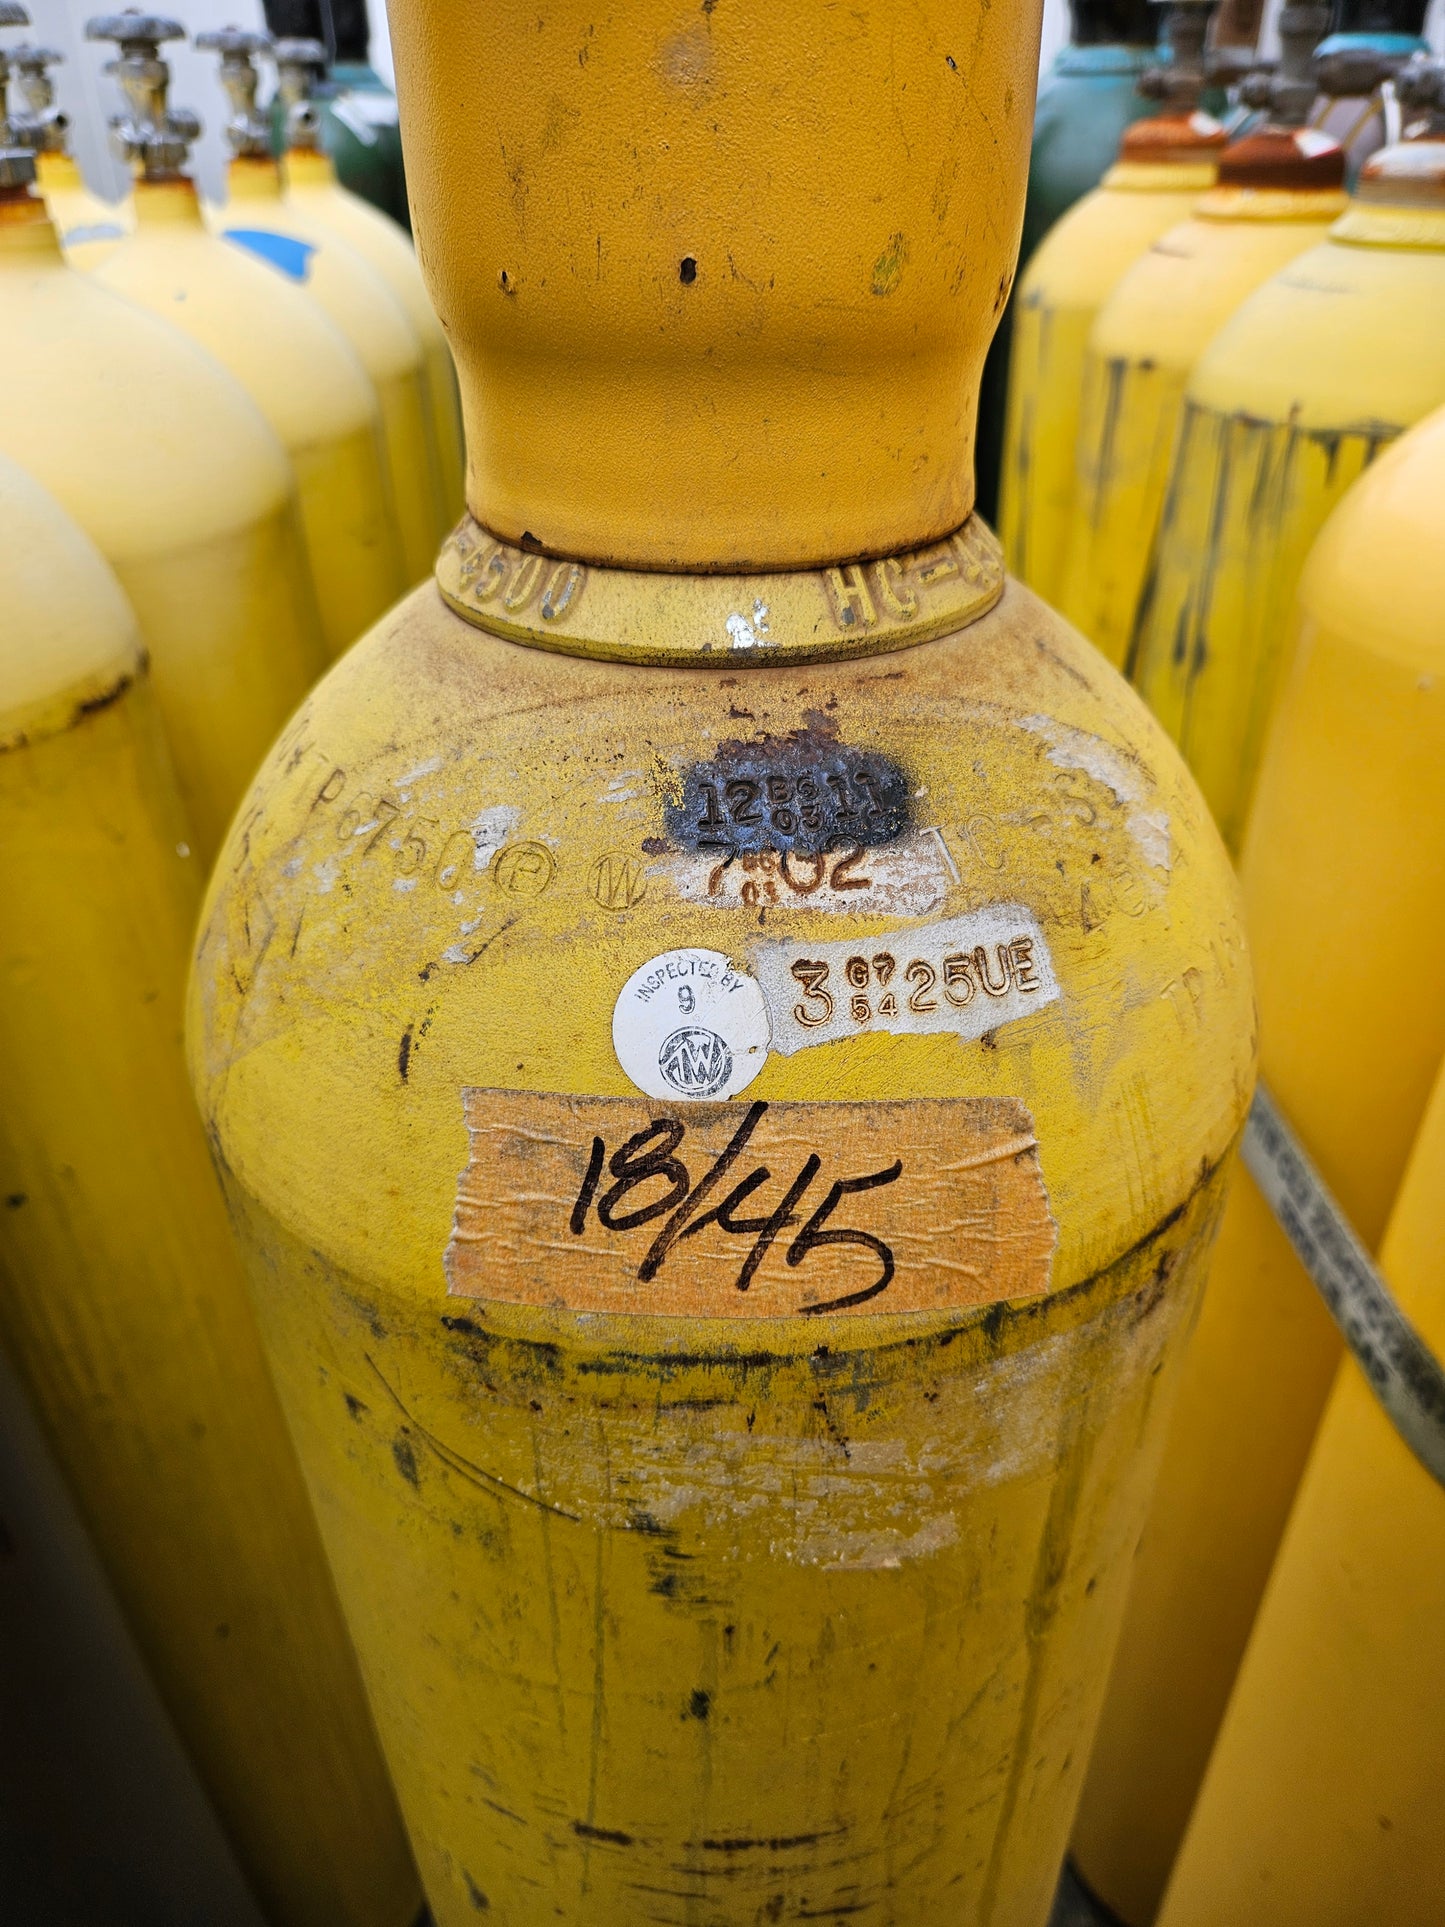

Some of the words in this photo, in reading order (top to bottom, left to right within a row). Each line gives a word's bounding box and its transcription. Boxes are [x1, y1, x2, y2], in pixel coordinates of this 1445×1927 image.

[698, 780, 762, 829] 12
[634, 961, 718, 1002] INSPECTED
[720, 972, 744, 993] BY
[677, 984, 696, 1015] 9
[791, 958, 833, 1028] 3
[852, 993, 898, 1023] 54
[570, 1101, 902, 1314] 18/45
